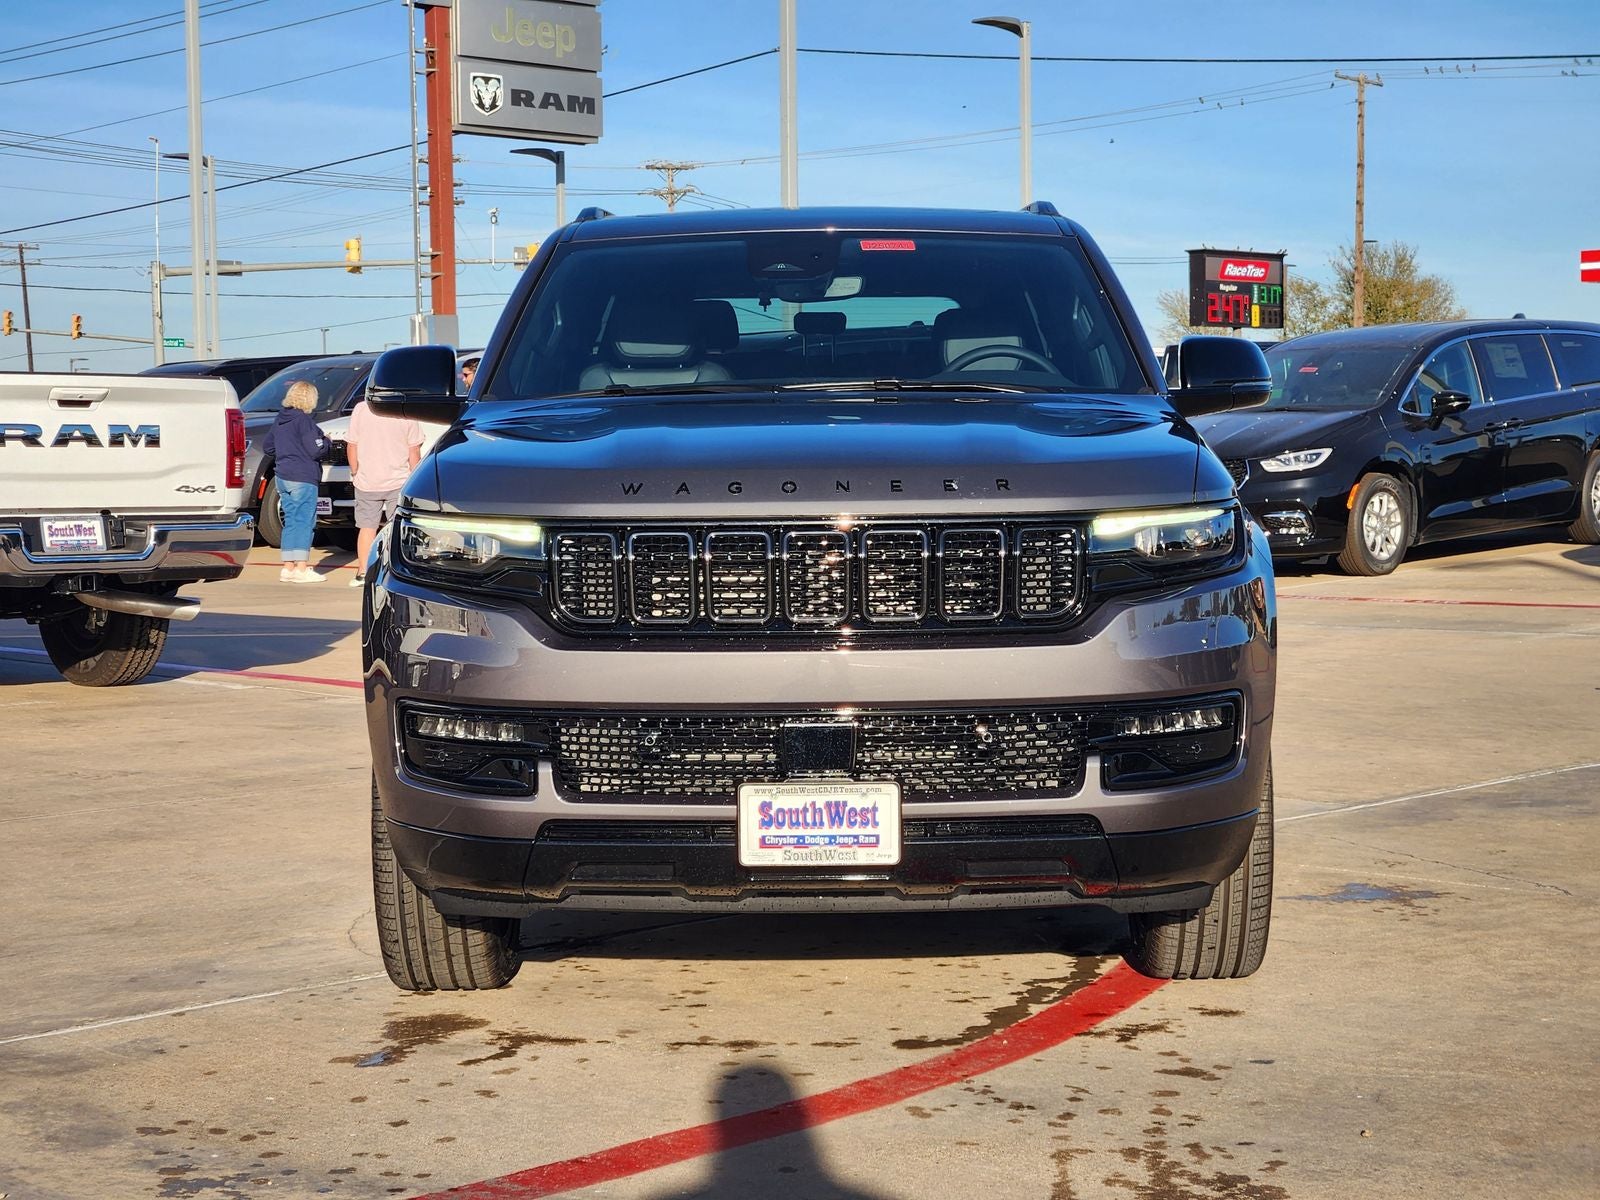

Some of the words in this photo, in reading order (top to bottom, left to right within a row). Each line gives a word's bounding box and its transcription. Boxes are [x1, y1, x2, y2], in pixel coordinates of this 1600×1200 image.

[490, 7, 576, 57] Jeep
[510, 88, 596, 115] RAM
[1224, 263, 1266, 278] RaceTrac
[0, 423, 160, 448] RAM
[175, 485, 217, 494] 4x4
[621, 478, 1011, 496] WAGONEER
[47, 524, 96, 537] SouthWest
[758, 800, 880, 830] SouthWest
[765, 836, 797, 845] Chrysler
[804, 836, 829, 845] Dodge
[835, 836, 853, 845] Jeep
[783, 849, 858, 861] SouthWest
